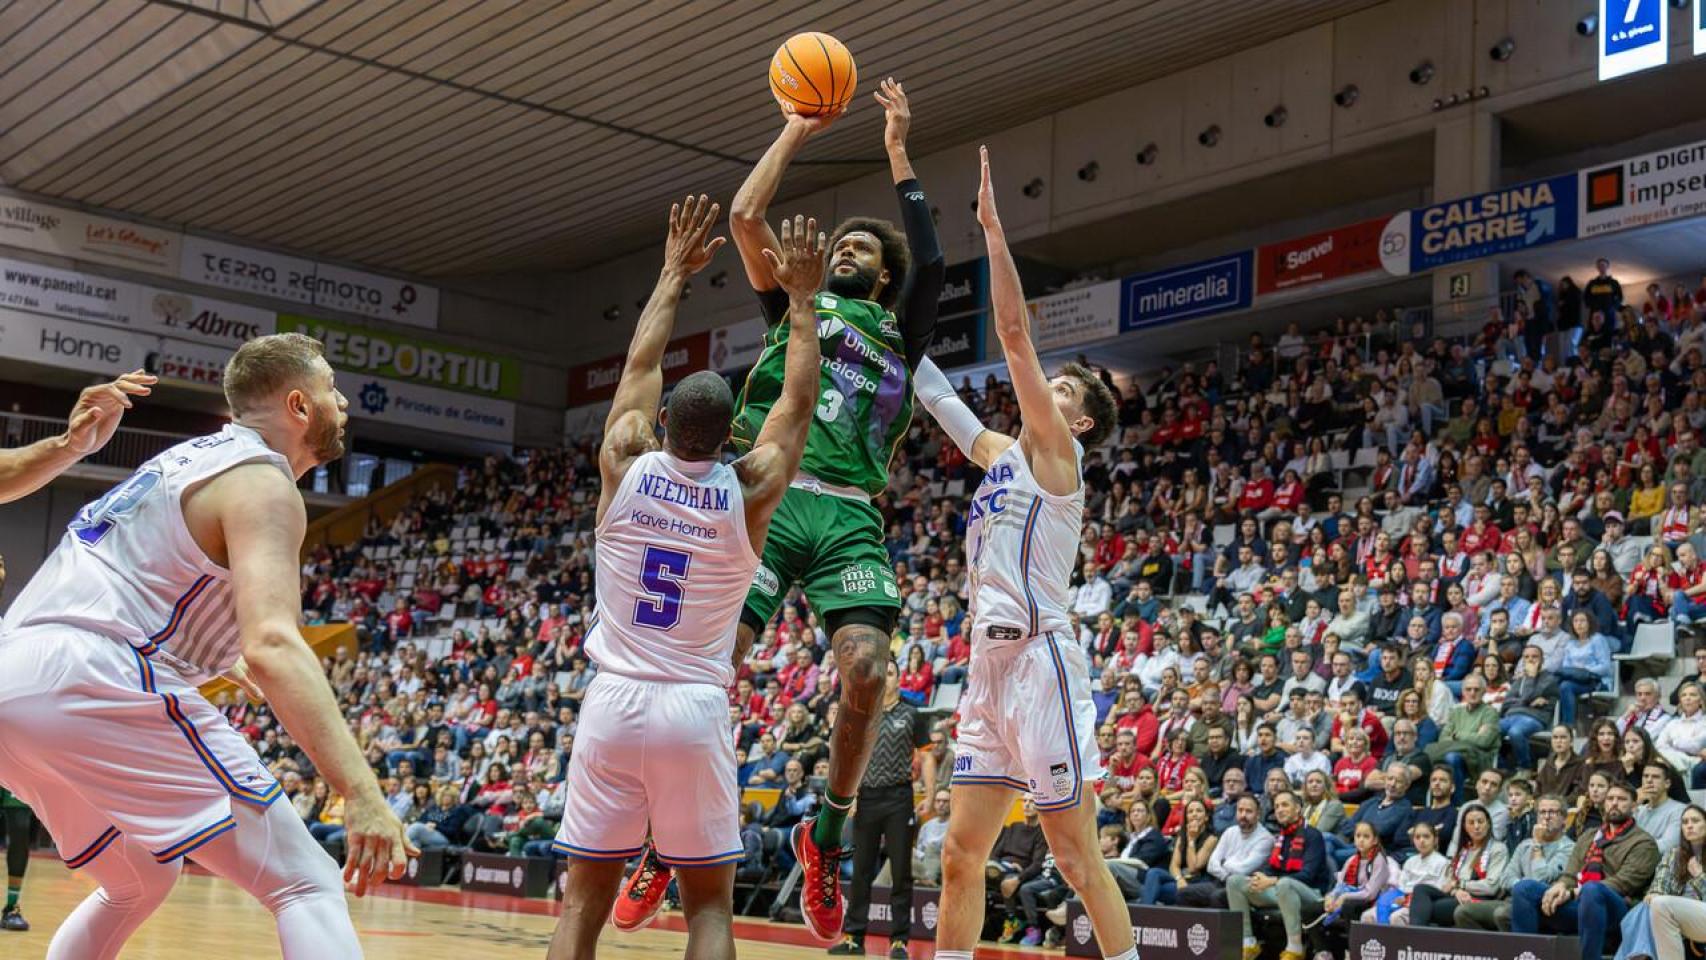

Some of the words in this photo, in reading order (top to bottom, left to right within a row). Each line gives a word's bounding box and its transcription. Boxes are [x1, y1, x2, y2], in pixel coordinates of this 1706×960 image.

[1630, 160, 1650, 176] La
[1421, 182, 1555, 232] CALSINA
[1421, 211, 1528, 256] CARRÉ
[4, 267, 117, 301] www.panella.cat
[288, 271, 383, 306] REMOTA
[1139, 275, 1229, 313] mineralia
[40, 328, 121, 363] Home
[298, 324, 500, 391] 'ESPORTIU
[844, 331, 898, 376] Unicaja
[463, 408, 505, 427] Girona
[816, 389, 844, 422] 3
[636, 473, 729, 511] NEEDHAM
[631, 508, 668, 530] Kave
[671, 520, 717, 539] Home
[632, 543, 693, 632] 5
[953, 755, 973, 772] SOY
[1142, 927, 1178, 949] GIRONA
